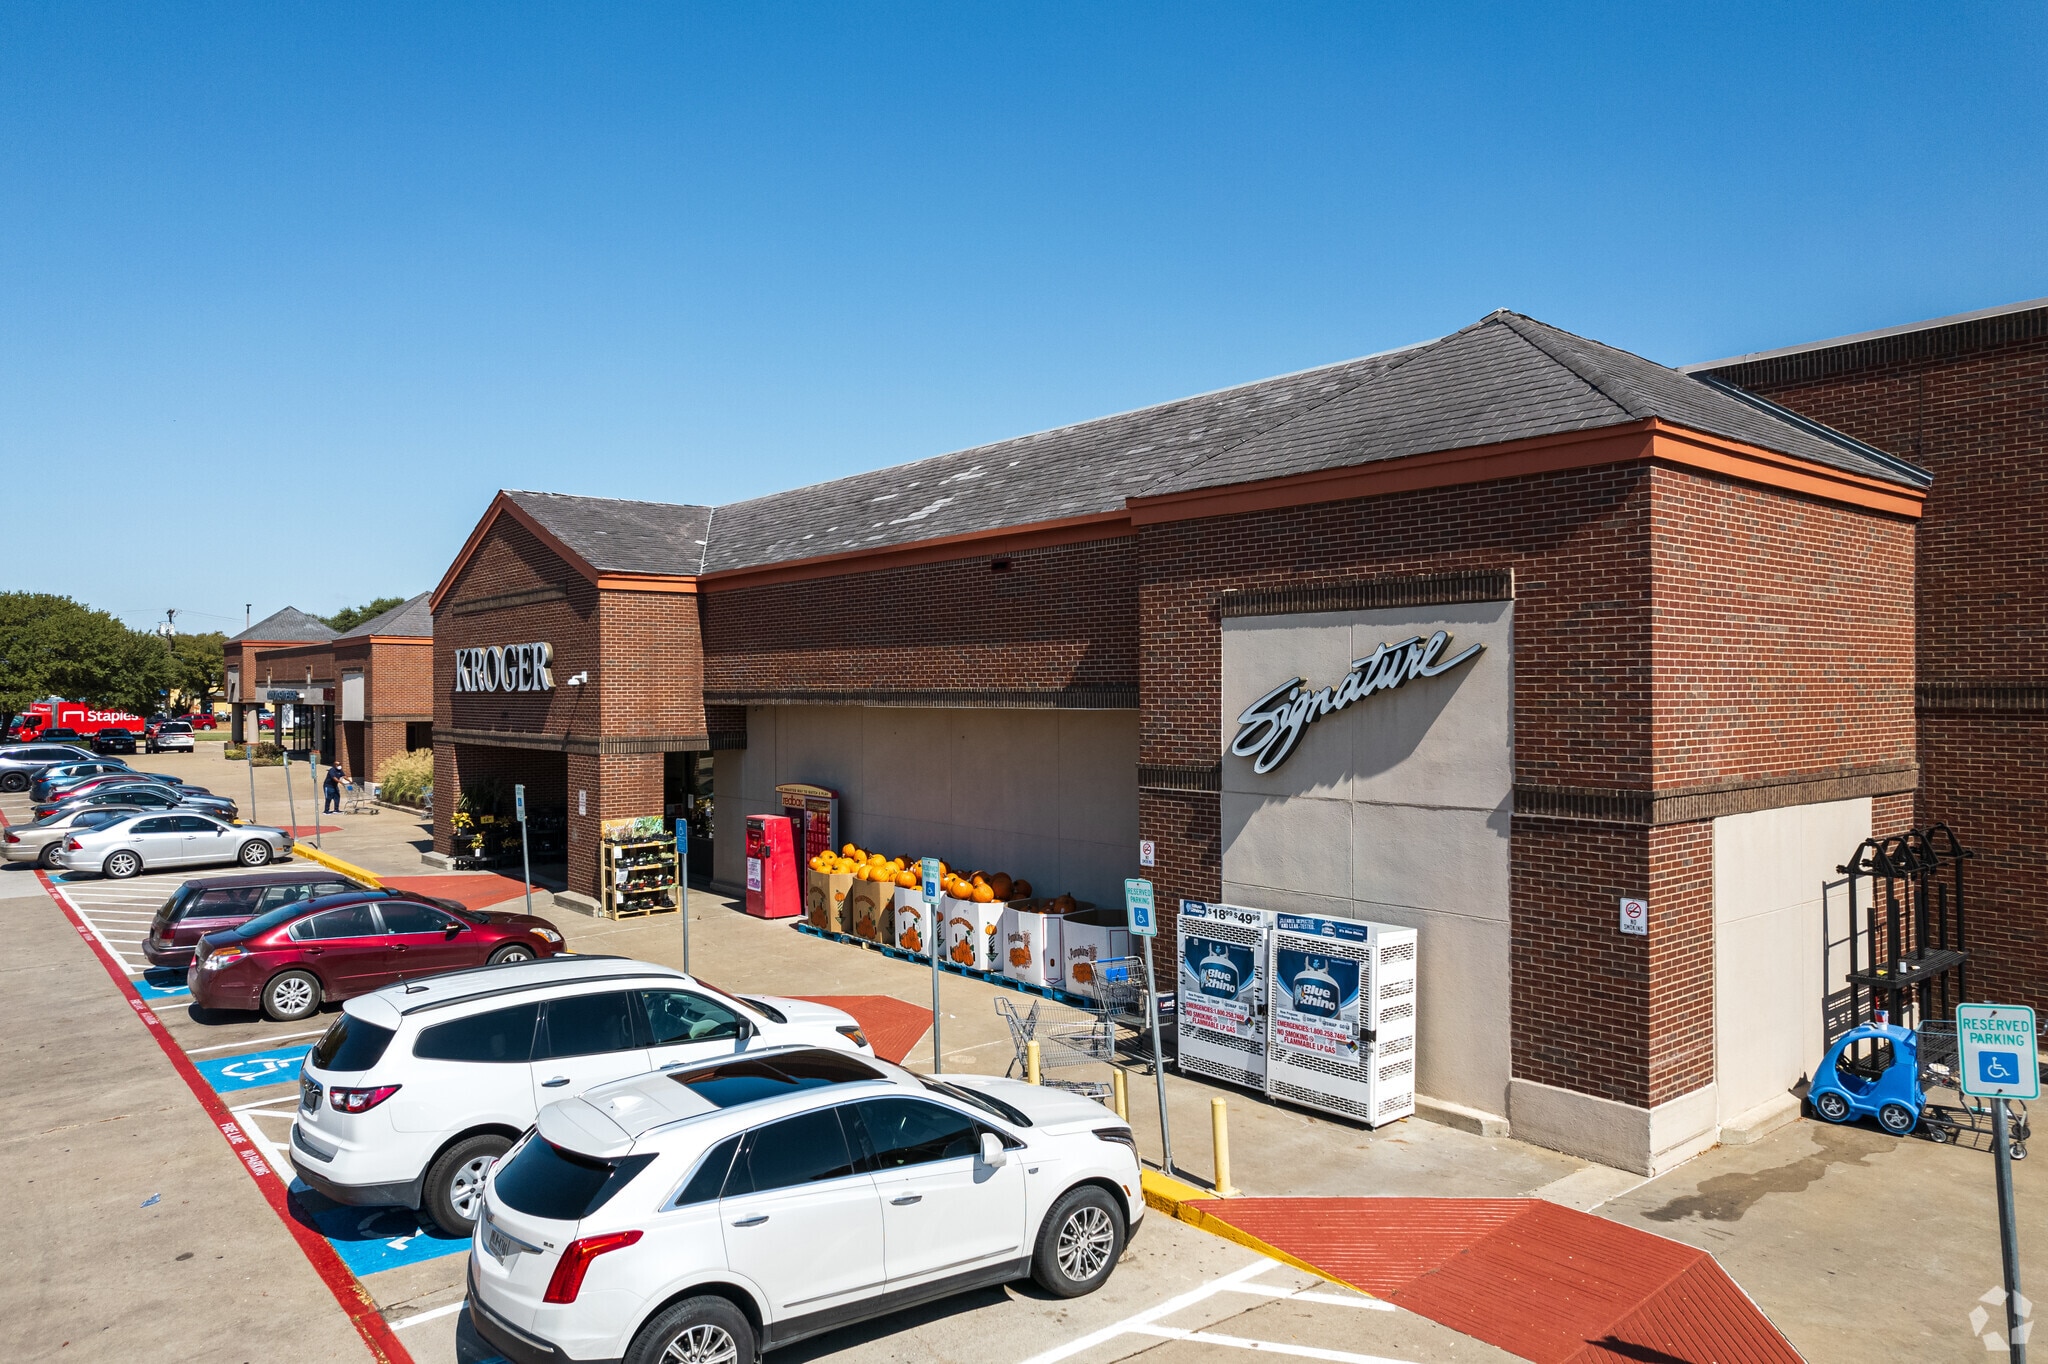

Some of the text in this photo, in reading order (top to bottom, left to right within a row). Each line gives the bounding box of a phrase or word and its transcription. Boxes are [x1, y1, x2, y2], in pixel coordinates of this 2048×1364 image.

[455, 642, 553, 692] KROGER
[1231, 629, 1484, 775] Signature
[87, 710, 139, 724] Staples
[1127, 887, 1152, 897] RESERVED
[1130, 896, 1150, 905] PARKING
[1624, 924, 1644, 932] SMOKING
[1069, 945, 1089, 959] Pumpkins
[1207, 968, 1231, 982] Blue
[1303, 984, 1330, 998] Blue
[1193, 1011, 1213, 1022] SMOKING
[1192, 1017, 1219, 1030] FLAMMABLE
[1219, 1023, 1226, 1031] LP
[1226, 1024, 1236, 1034] GAS
[1277, 1020, 1309, 1032] EMERGENCIES:
[1963, 1018, 2030, 1033] RESERVED
[1285, 1030, 1309, 1041] SMOKING
[1969, 1032, 2025, 1047] PARKING
[1284, 1037, 1316, 1050] FLAMMABLE
[1317, 1043, 1324, 1051] LP
[1324, 1045, 1336, 1055] GAS
[220, 1121, 247, 1145] FIRE LANE
